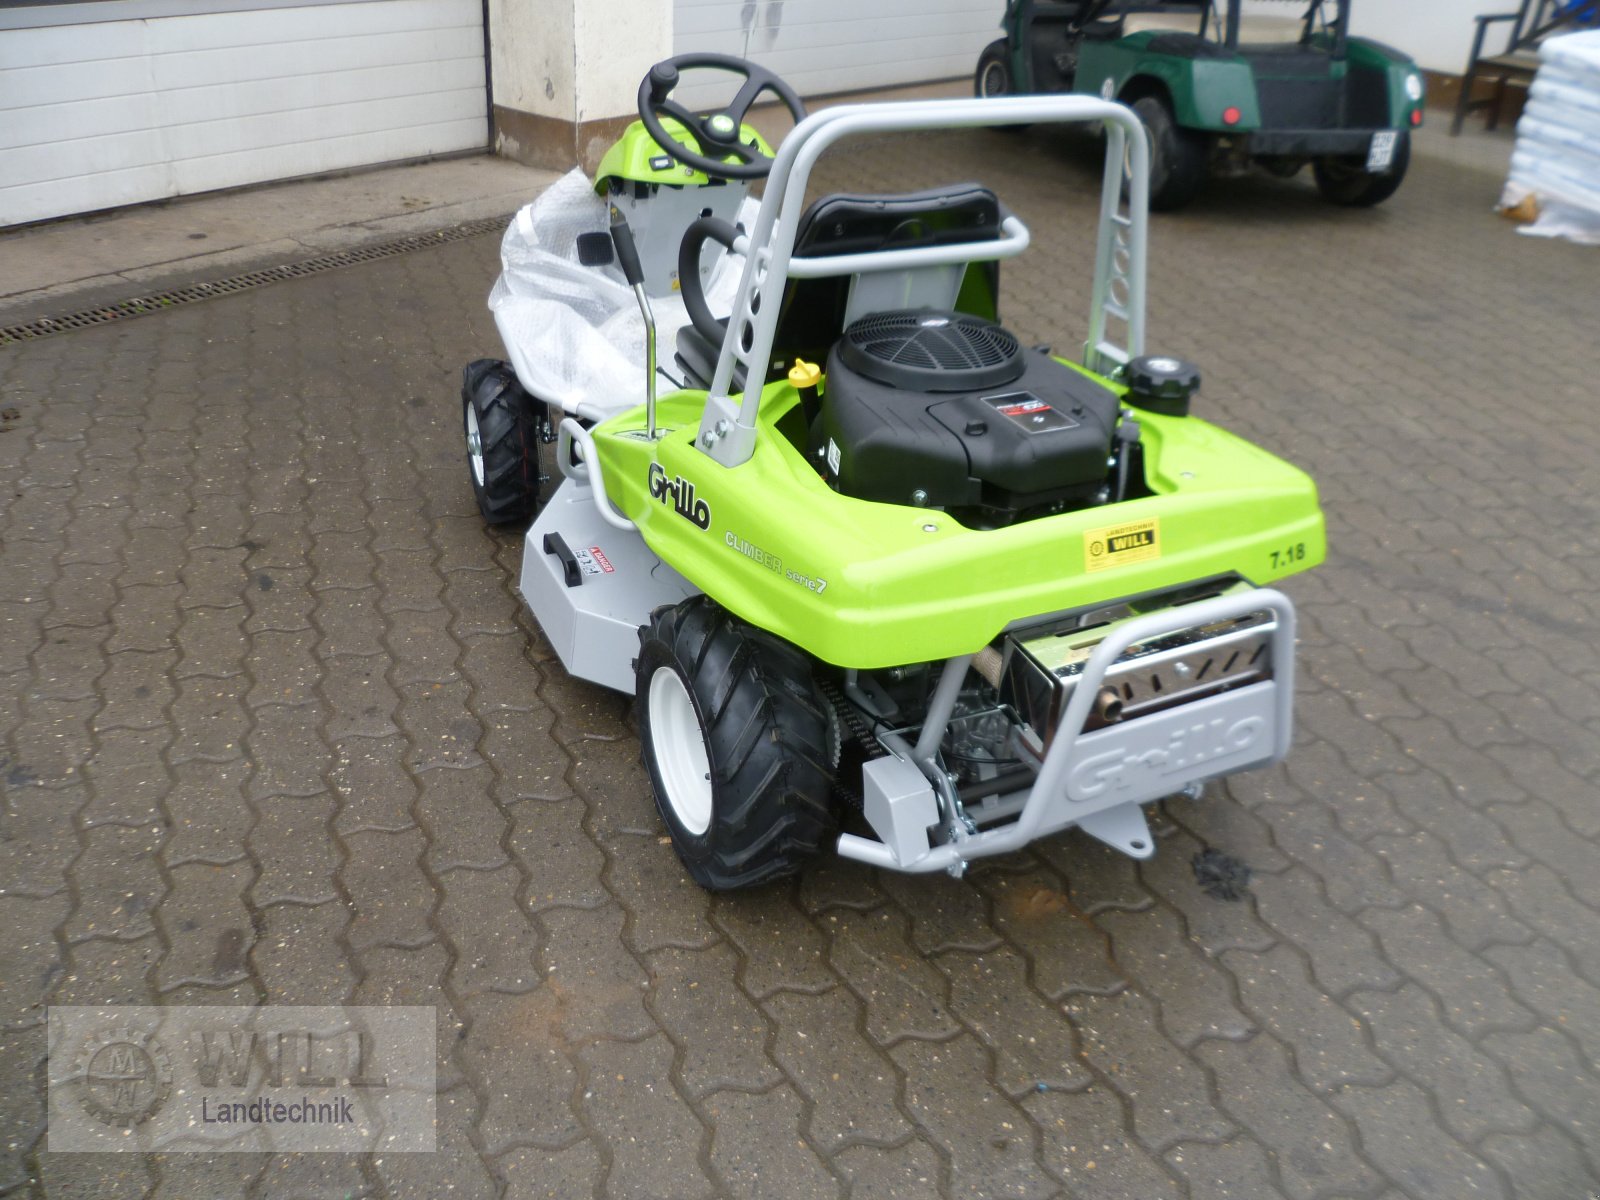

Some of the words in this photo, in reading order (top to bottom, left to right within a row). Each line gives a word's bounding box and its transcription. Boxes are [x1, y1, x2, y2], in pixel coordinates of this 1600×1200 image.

[648, 462, 711, 531] Grillo
[1105, 521, 1154, 537] LANDTECHNIK
[1112, 532, 1150, 551] WILL
[595, 551, 614, 573] DANGER
[725, 531, 783, 575] CLIMBER
[1269, 542, 1305, 569] 7.18
[1065, 714, 1265, 802] Grillo
